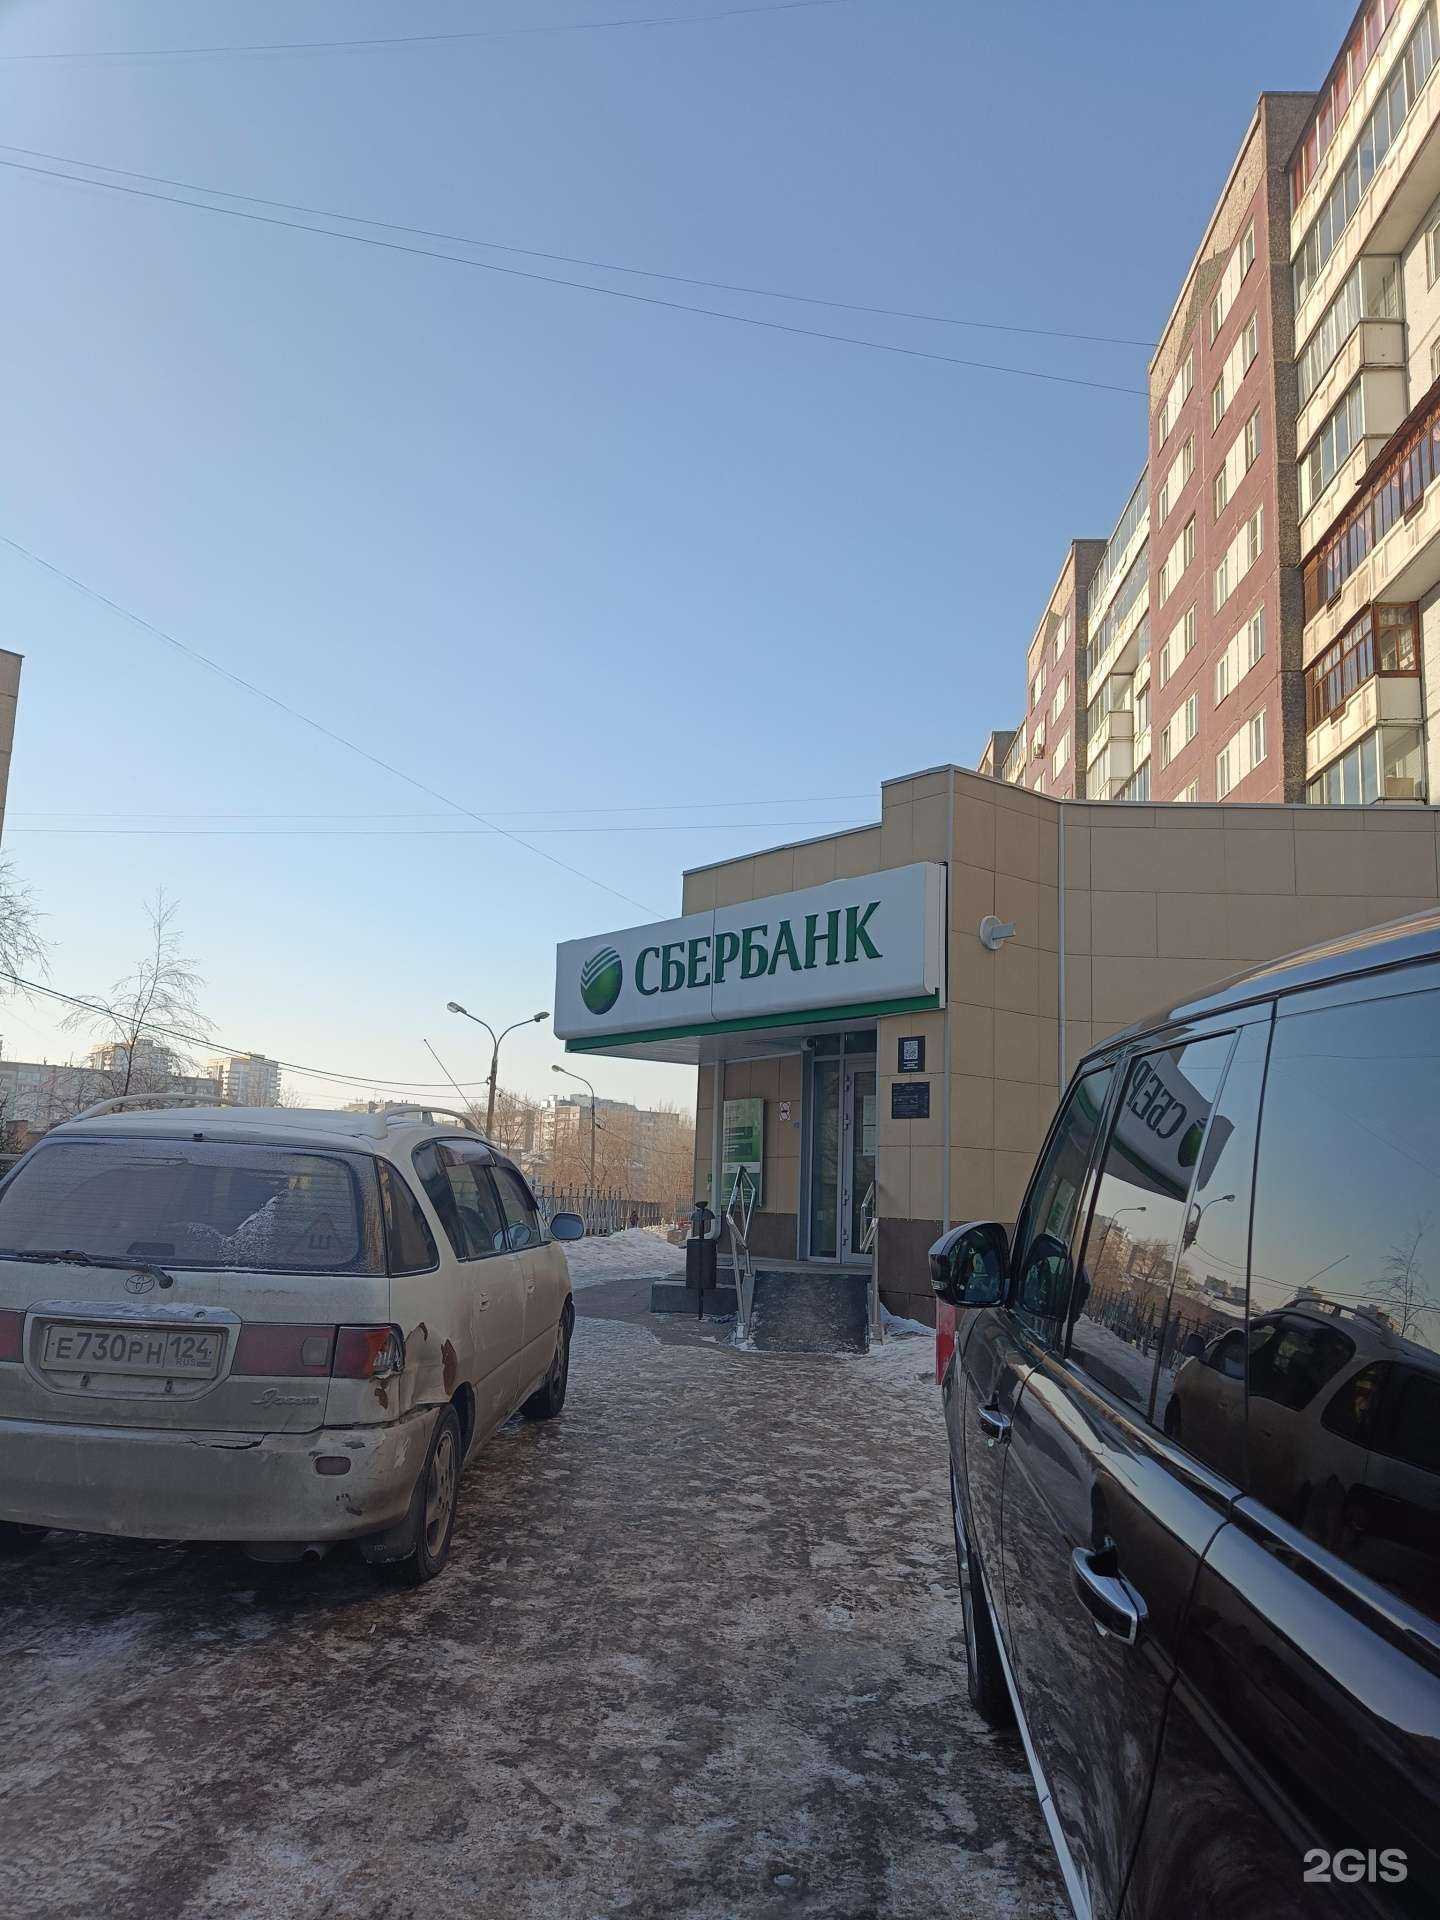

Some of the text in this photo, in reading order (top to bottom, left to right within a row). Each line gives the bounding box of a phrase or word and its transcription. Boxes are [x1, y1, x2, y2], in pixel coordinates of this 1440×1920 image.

[635, 901, 882, 995] СБЕРБАНК
[56, 1332, 209, 1364] Е730РН 124
